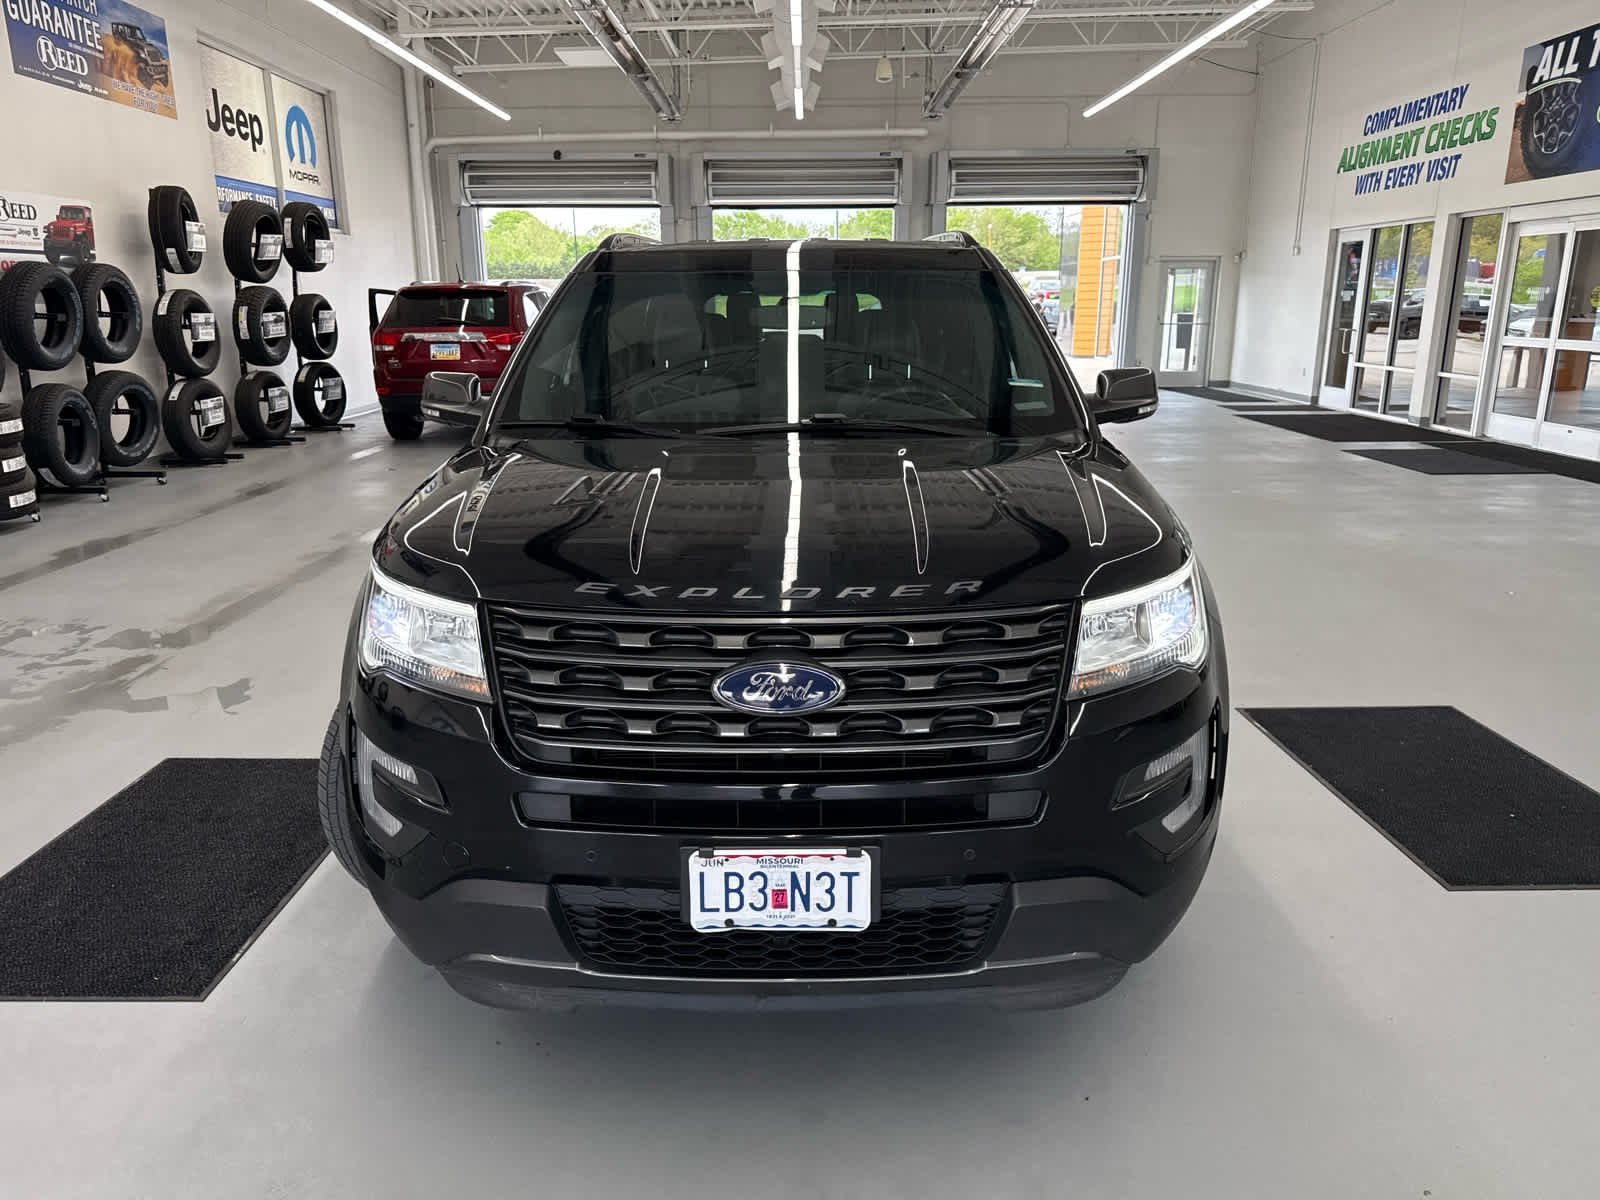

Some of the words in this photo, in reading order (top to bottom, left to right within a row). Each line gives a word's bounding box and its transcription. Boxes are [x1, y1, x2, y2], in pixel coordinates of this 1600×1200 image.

[7, 0, 104, 51] GUARANTEE
[38, 37, 88, 76] REED
[1532, 36, 1580, 84] ALL
[206, 88, 263, 152] Jeep
[1363, 83, 1470, 137] COMPLIMENTARY
[1336, 126, 1426, 174] ALIGNMENT
[1424, 106, 1500, 154] CHECKS
[289, 170, 320, 185] MOPAR
[1354, 169, 1382, 196] WITH
[1384, 161, 1425, 190] EVERY
[1425, 153, 1463, 183] VISIT
[573, 579, 984, 600] EXPLORER
[742, 671, 824, 702] Ford
[700, 858, 724, 867] JUN
[756, 857, 804, 865] MISSOURI
[699, 871, 768, 913] LB3
[790, 871, 860, 913] N3T
[774, 892, 785, 903] 27
